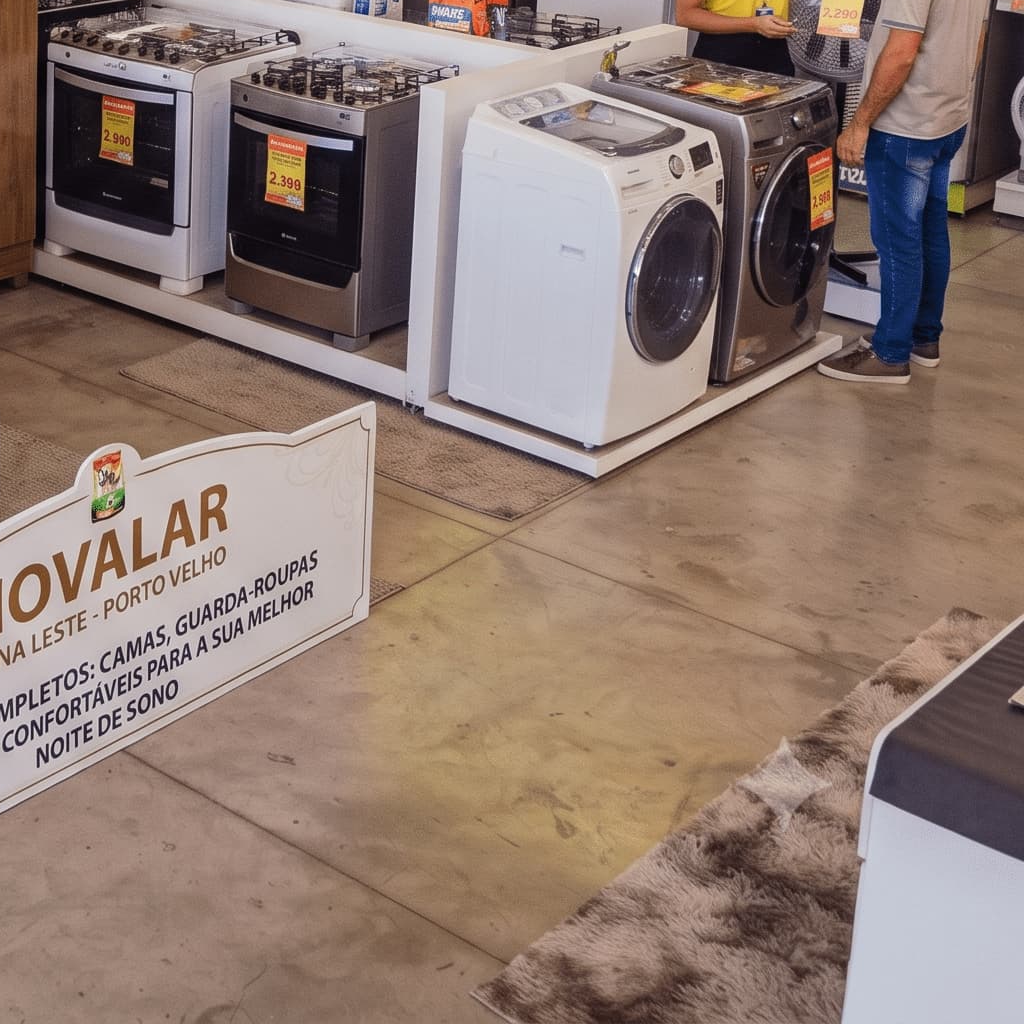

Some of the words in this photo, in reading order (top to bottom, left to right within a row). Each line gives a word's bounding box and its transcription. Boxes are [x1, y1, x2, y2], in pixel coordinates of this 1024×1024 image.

[32, 610, 88, 655] LESTE
[103, 574, 166, 620] PORTO
[168, 545, 227, 588] VELHO
[99, 624, 171, 674] CAMAS,
[175, 549, 319, 637] GUARDA-ROUPAS
[1, 666, 144, 753] CONFORTÁVEIS
[146, 642, 193, 682] PARA
[195, 635, 209, 658] A
[211, 617, 244, 649] SUA
[247, 580, 314, 630] MELHOR
[35, 720, 93, 769] NOITE
[97, 707, 122, 737] DE
[126, 679, 179, 722] SONO
